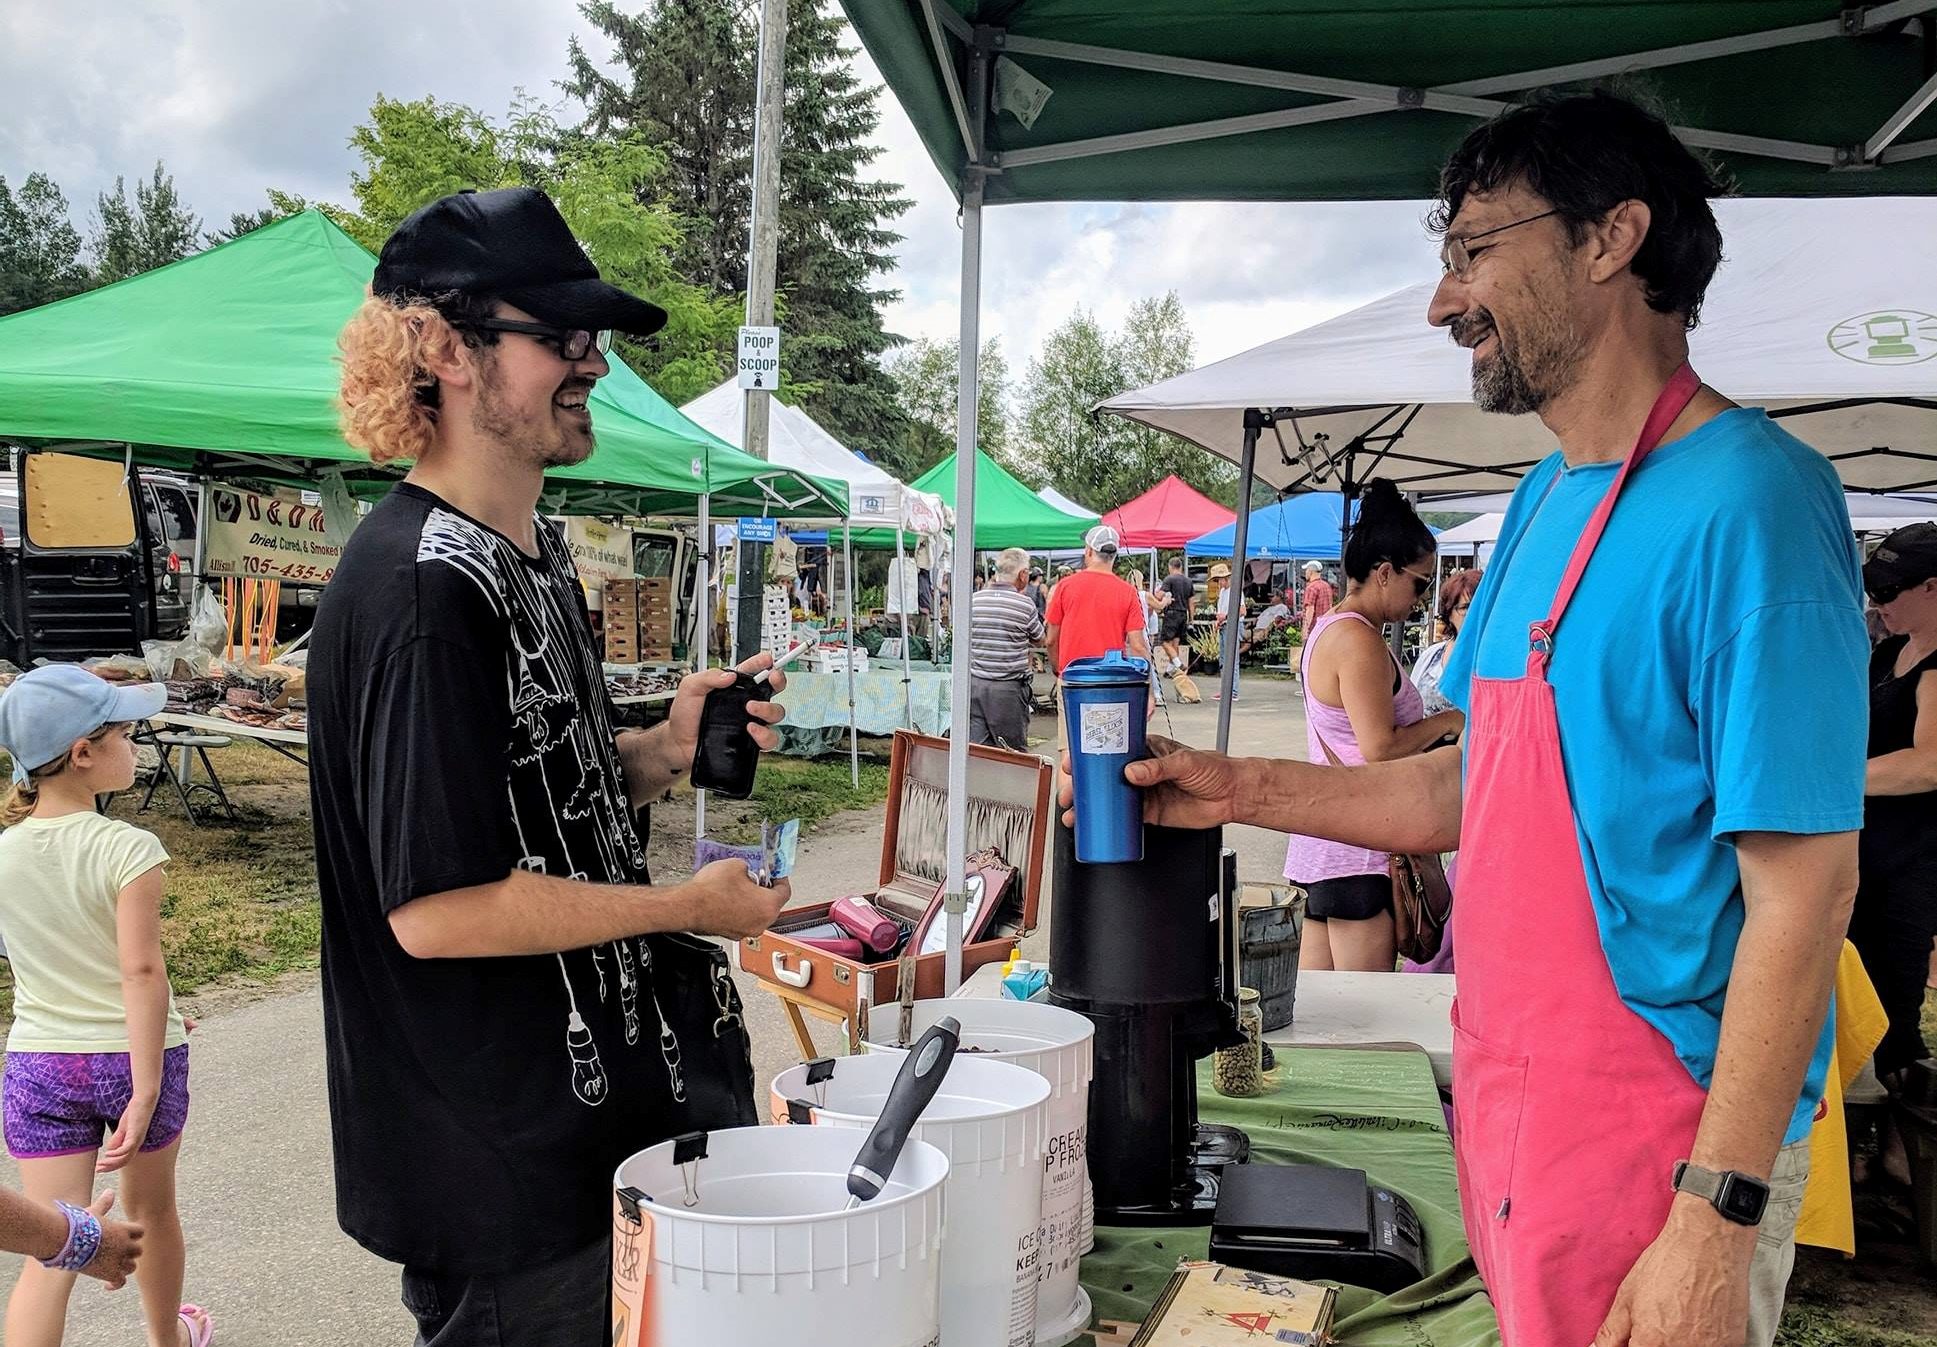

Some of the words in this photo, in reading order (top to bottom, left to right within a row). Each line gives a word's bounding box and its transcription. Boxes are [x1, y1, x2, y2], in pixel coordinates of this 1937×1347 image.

[744, 336, 774, 349] POOP
[740, 358, 777, 371] SCOOP
[266, 500, 283, 527] &
[249, 532, 278, 552] Dried,
[310, 541, 340, 557] Smoked
[1018, 1231, 1035, 1251] ICE
